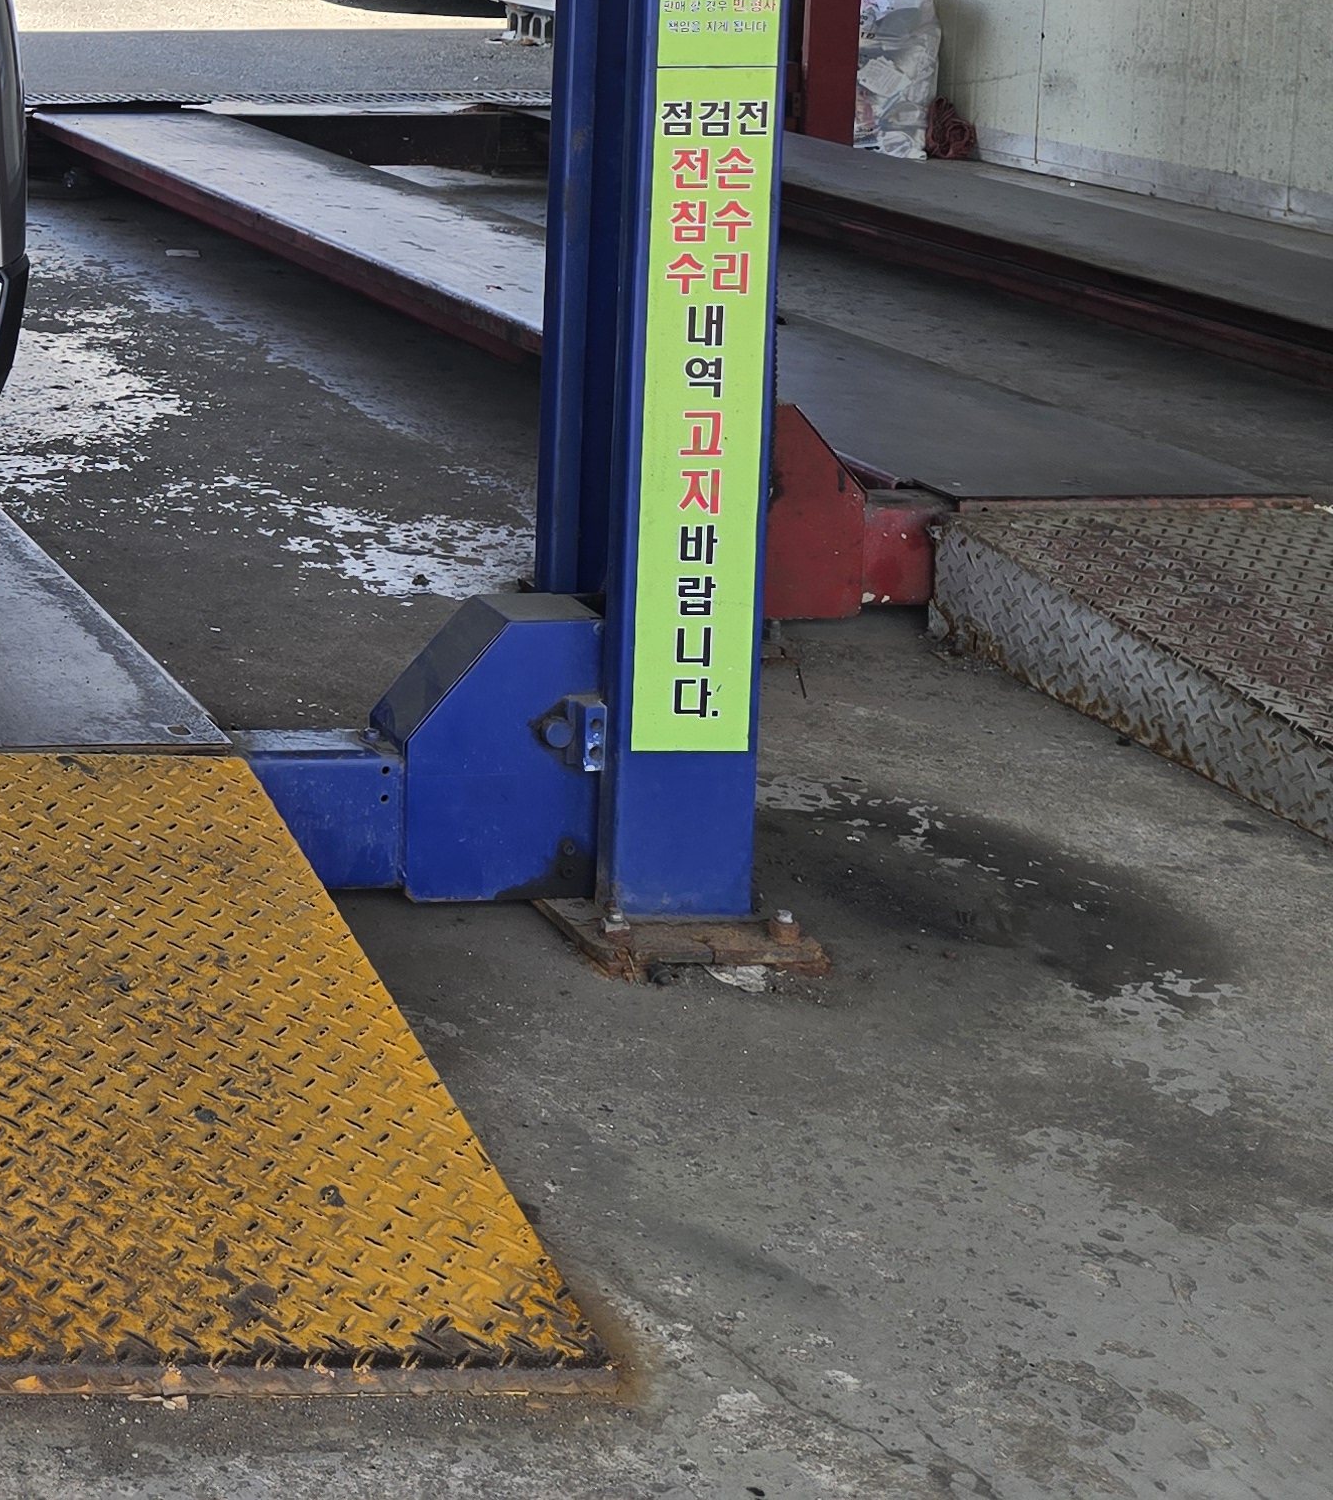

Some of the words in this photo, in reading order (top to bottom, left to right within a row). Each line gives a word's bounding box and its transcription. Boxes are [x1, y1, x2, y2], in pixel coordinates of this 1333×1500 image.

[661, 100, 769, 136] 점검전
[671, 148, 754, 190] 전손
[669, 201, 752, 242] 침수
[666, 253, 750, 294] 수리
